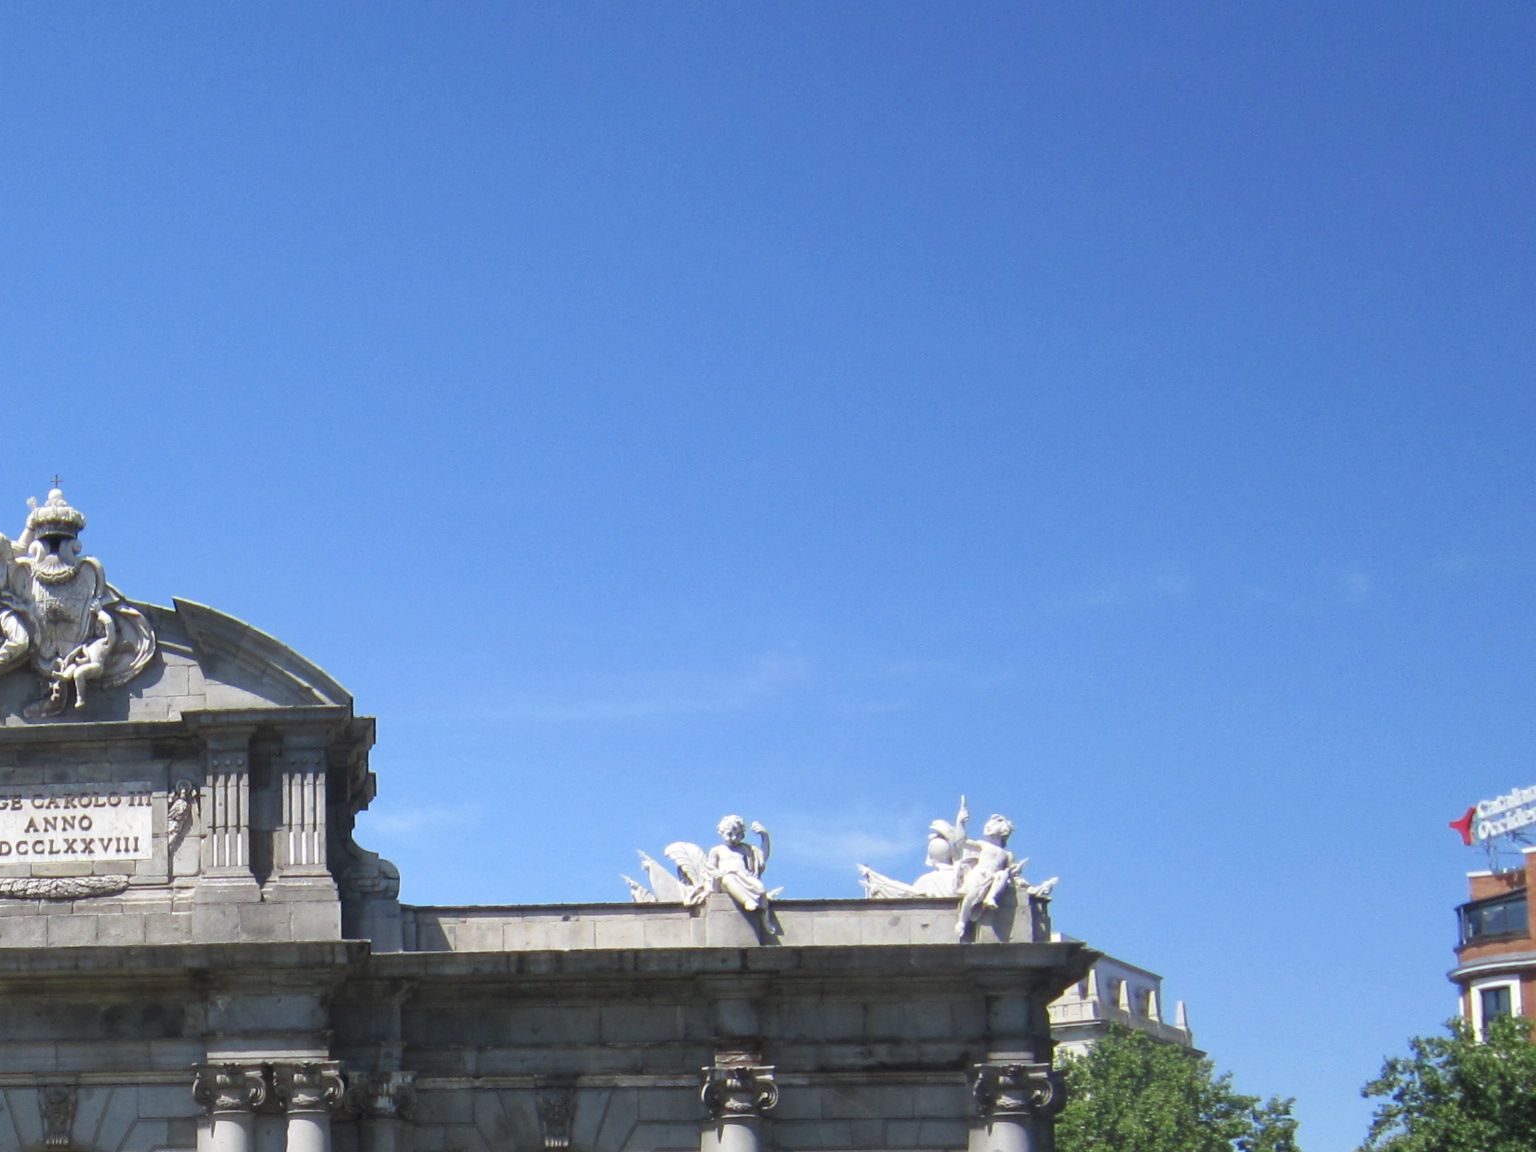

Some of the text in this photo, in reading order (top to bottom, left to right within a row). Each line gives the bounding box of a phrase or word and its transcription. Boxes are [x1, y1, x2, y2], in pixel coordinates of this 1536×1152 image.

[30, 791, 122, 810] CAROLO
[128, 790, 153, 807] III
[23, 814, 93, 833] ANNO
